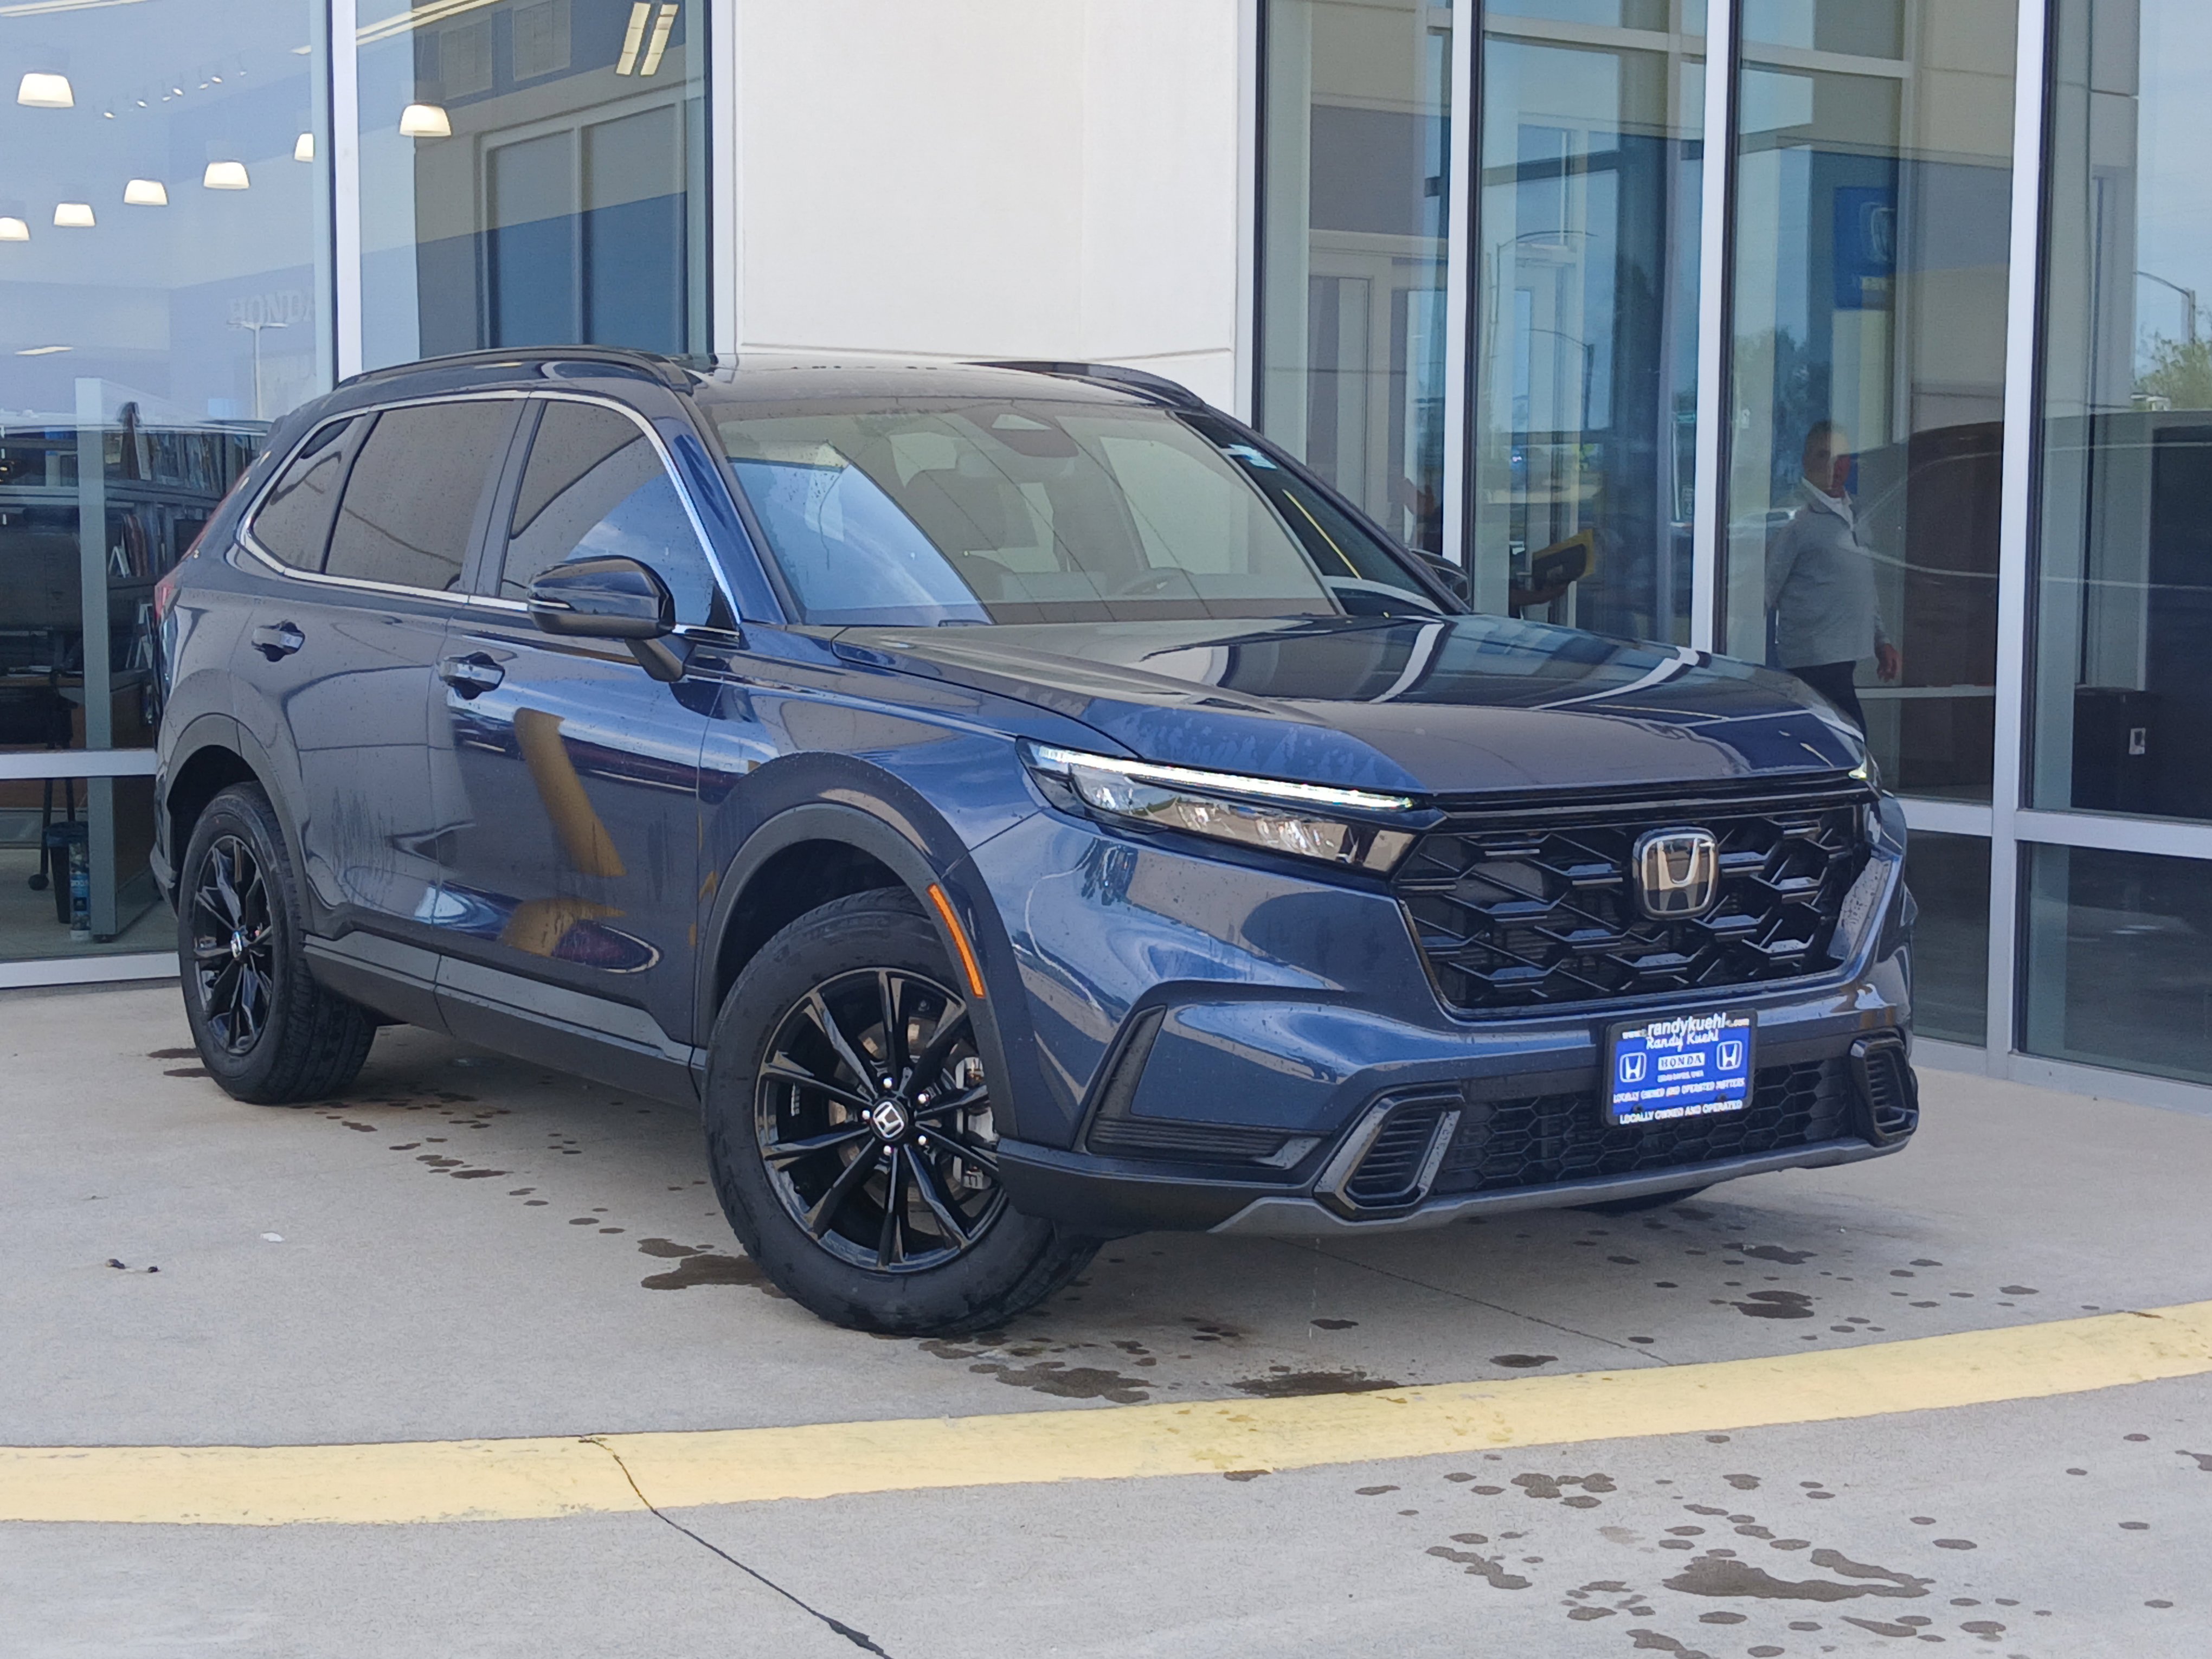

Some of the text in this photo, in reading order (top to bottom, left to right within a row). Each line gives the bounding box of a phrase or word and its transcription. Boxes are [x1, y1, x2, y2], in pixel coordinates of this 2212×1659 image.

[1646, 1028, 1719, 1052] Randy Kuehl
[1661, 1054, 1702, 1068] HONDA
[1620, 1111, 1654, 1124] LOCALLY
[1684, 1105, 1701, 1116] AND
[1702, 1099, 1742, 1113] OPERATED
